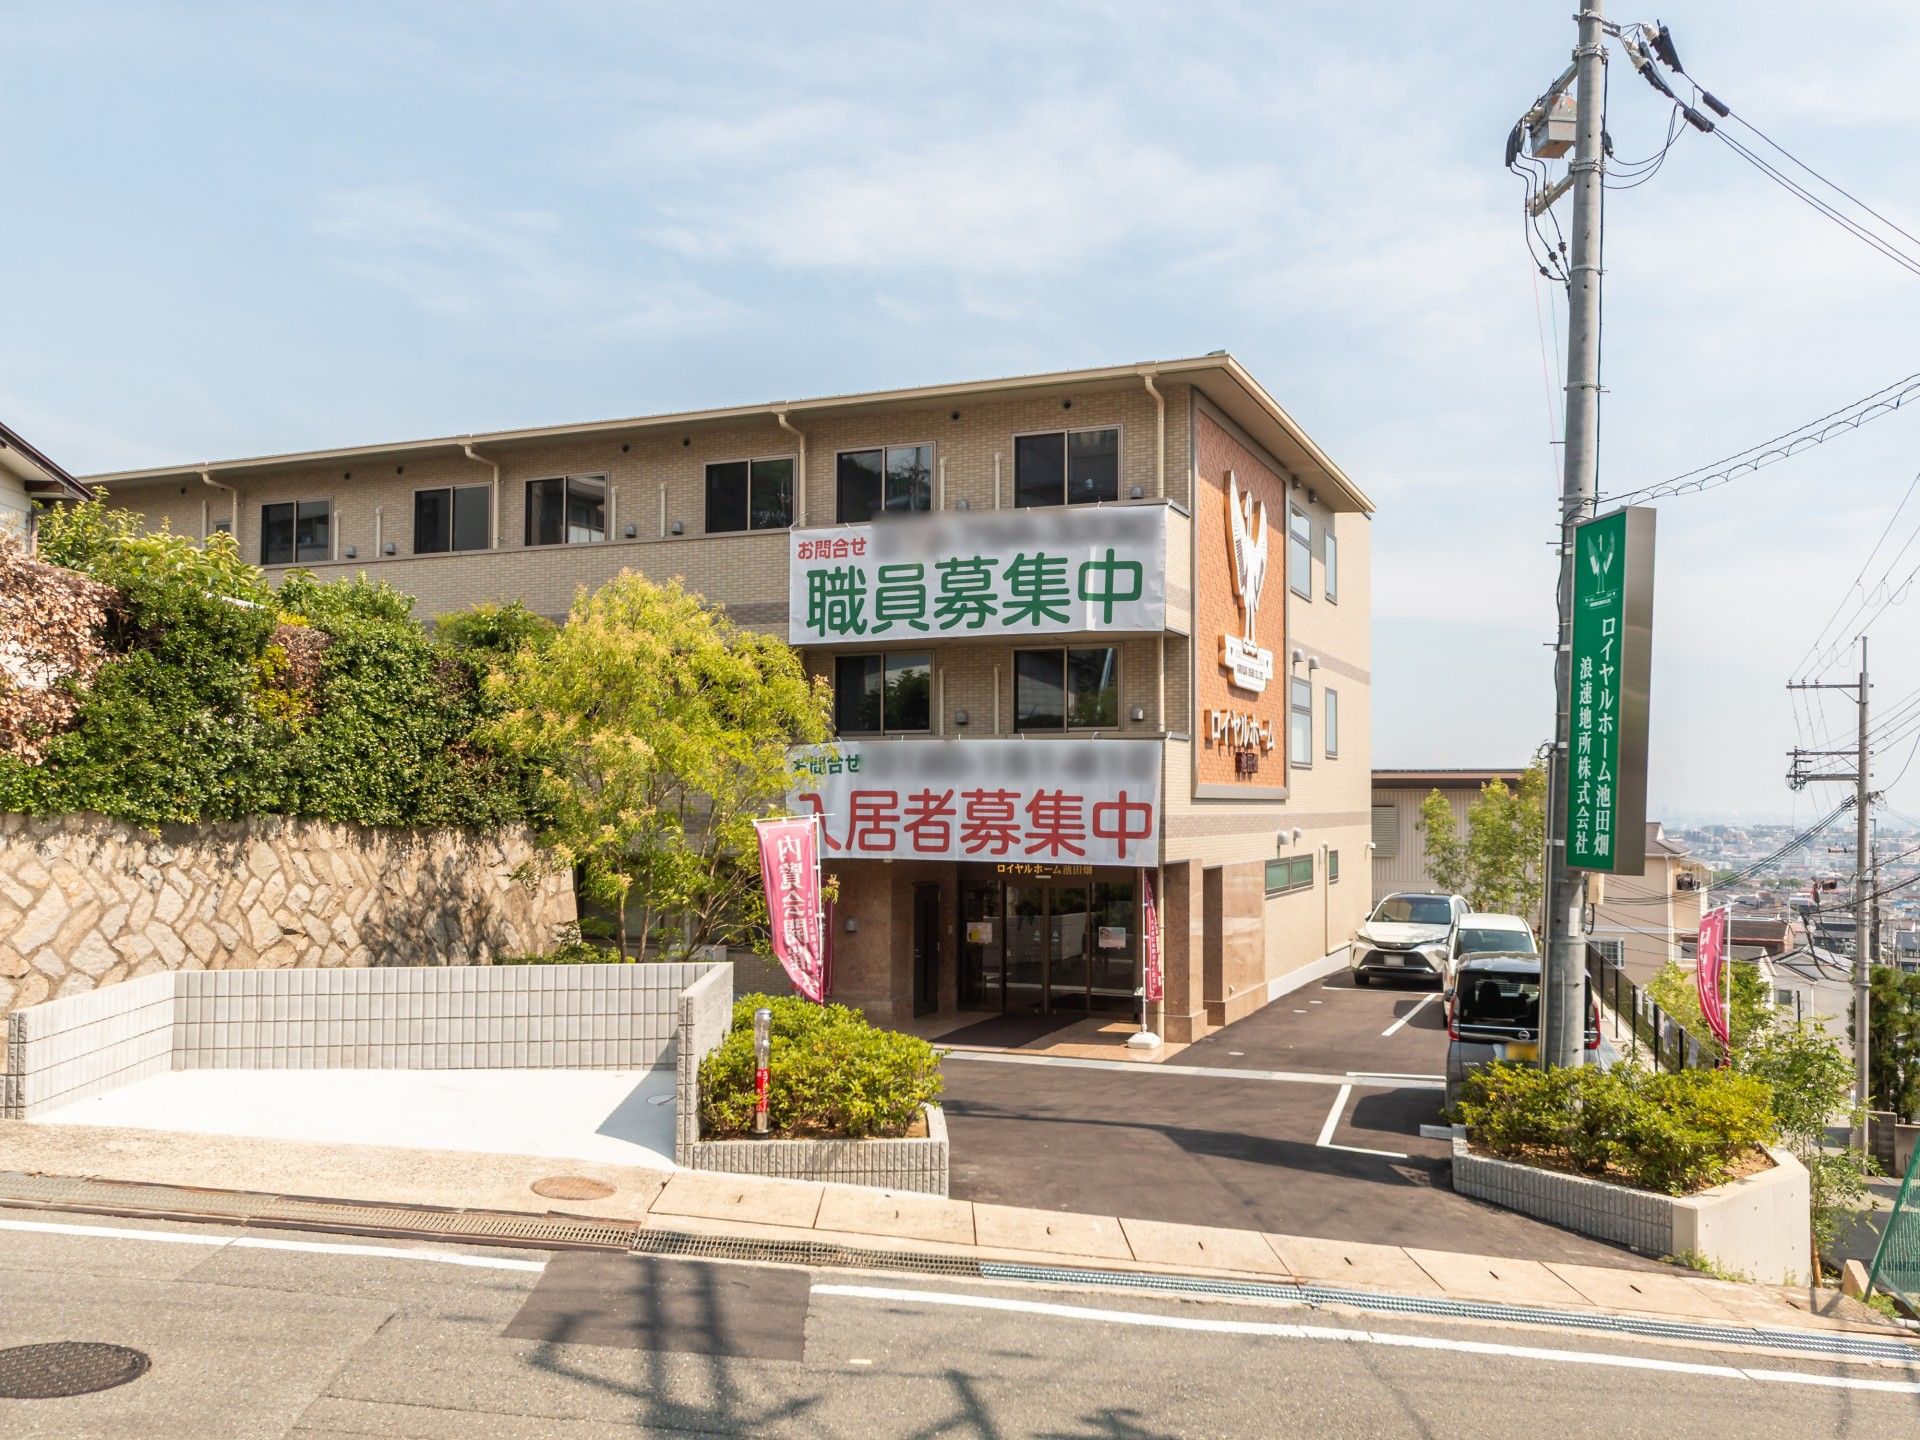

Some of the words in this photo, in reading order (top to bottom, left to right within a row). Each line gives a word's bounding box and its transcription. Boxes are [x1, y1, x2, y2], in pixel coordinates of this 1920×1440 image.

[797, 537, 867, 560] お問合せ
[806, 547, 1144, 638] 職員募集中
[1211, 709, 1275, 751] ロイヤルホーム
[1575, 656, 1593, 855] 浪速地所株式会社
[1593, 617, 1616, 856] ロイヤルホーム池田畑
[798, 786, 1154, 860] 入居者募集中
[997, 863, 1093, 875] ロイヤルホーム池田畑
